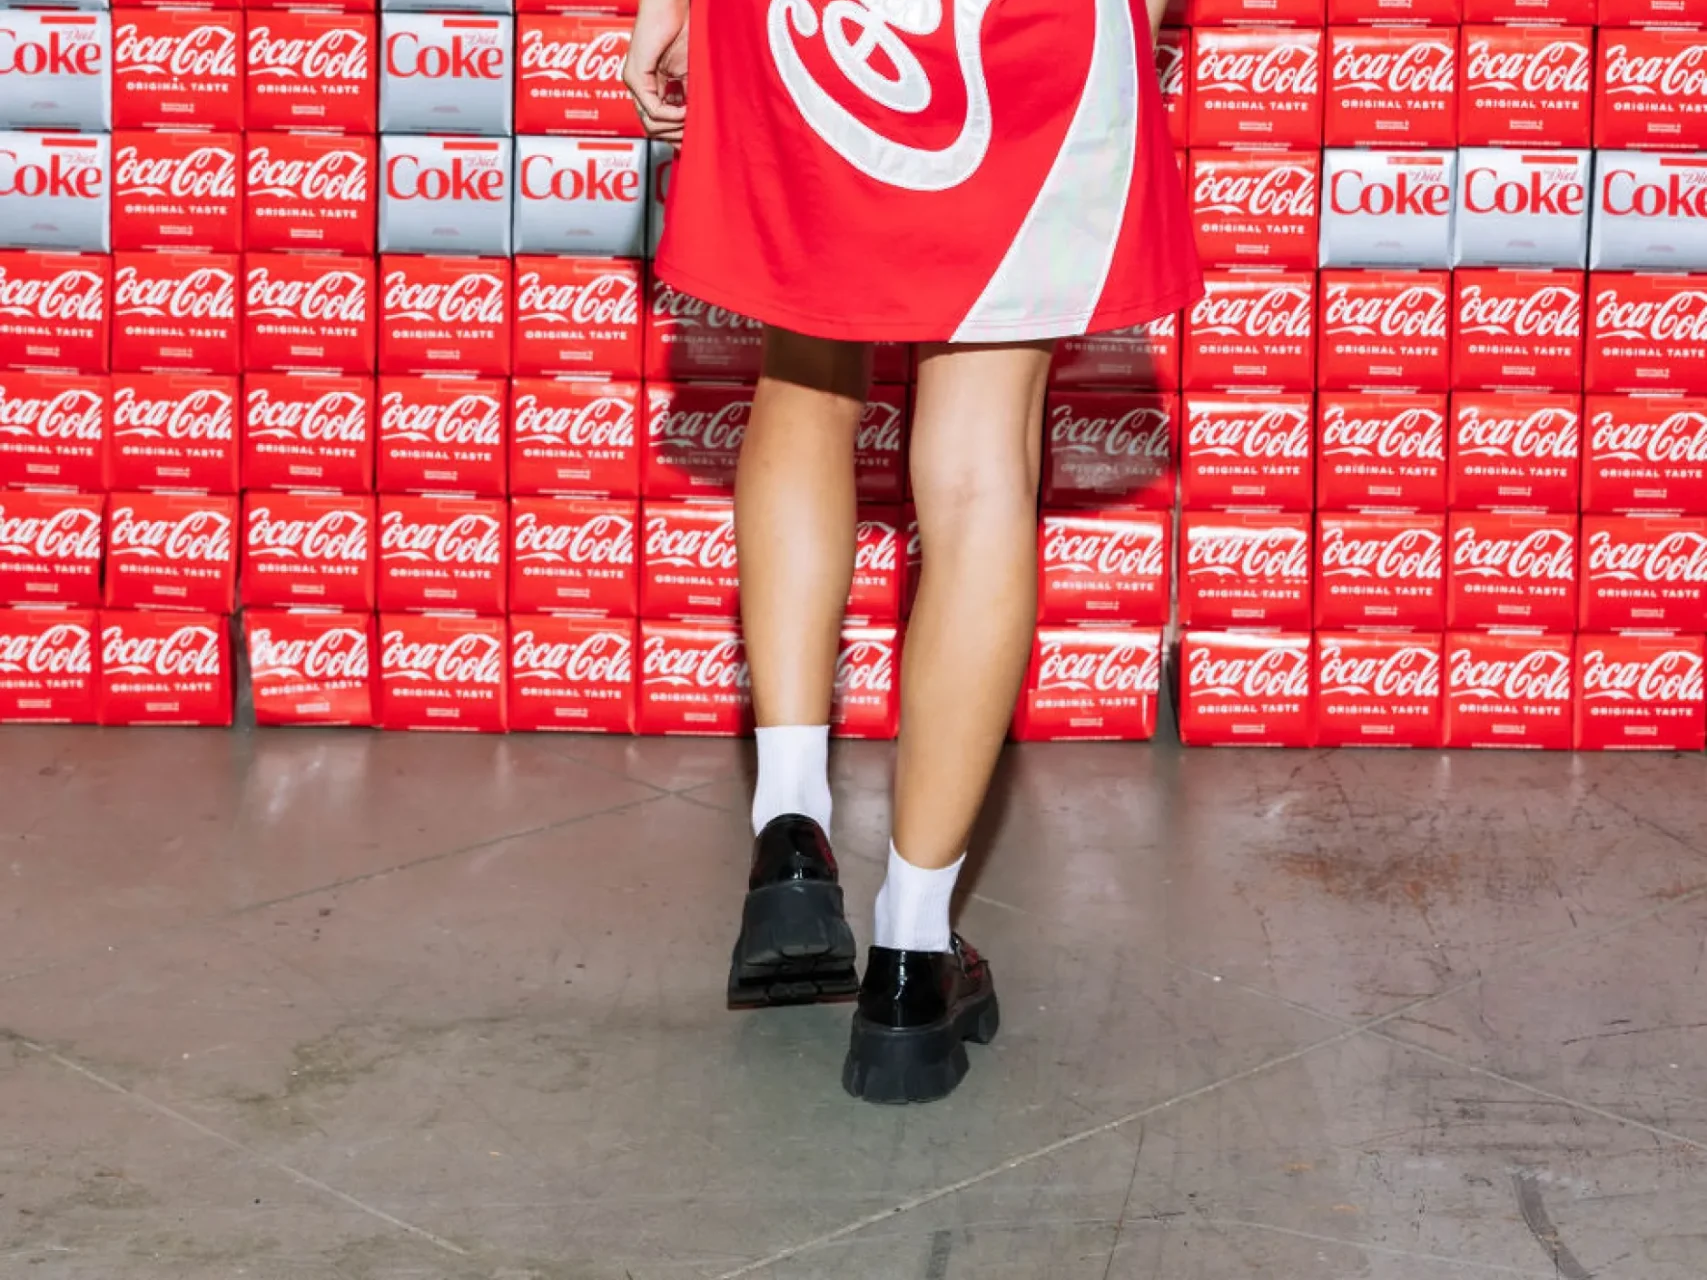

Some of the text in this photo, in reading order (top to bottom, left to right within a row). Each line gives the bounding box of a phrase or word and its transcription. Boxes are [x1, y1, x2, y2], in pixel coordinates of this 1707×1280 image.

[385, 32, 505, 81] Coke
[255, 83, 361, 96] ORIGINAL TASTE
[1340, 98, 1446, 111] ORIGINAL TASTE
[385, 154, 505, 202] Coke
[520, 155, 640, 203] Coke
[1330, 170, 1451, 217] Coke
[1463, 169, 1585, 216] Coke
[123, 203, 228, 216] ORIGINAL TASTE
[1200, 222, 1305, 235] ORIGINAL TASTE
[123, 324, 228, 339] ORIGINAL TASTE
[391, 329, 495, 340] ORIGINAL TASTE
[1334, 344, 1439, 357] ORIGINAL TASTE
[255, 442, 357, 459] ORIGINAL TASTE
[522, 447, 626, 461] ORIGINAL TASTE
[1196, 463, 1301, 476] ORIGINAL TASTE
[1463, 463, 1568, 478] ORIGINAL TASTE
[257, 562, 360, 576] ORIGINAL TASTE
[1051, 579, 1155, 592] ORIGINAL TASTE
[1596, 587, 1701, 600] ORIGINAL TASTE
[109, 681, 213, 694] ORIGINAL TASTE
[520, 686, 622, 700] ORIGINAL TASTE
[1589, 705, 1694, 718] ORIGINAL TASTE
